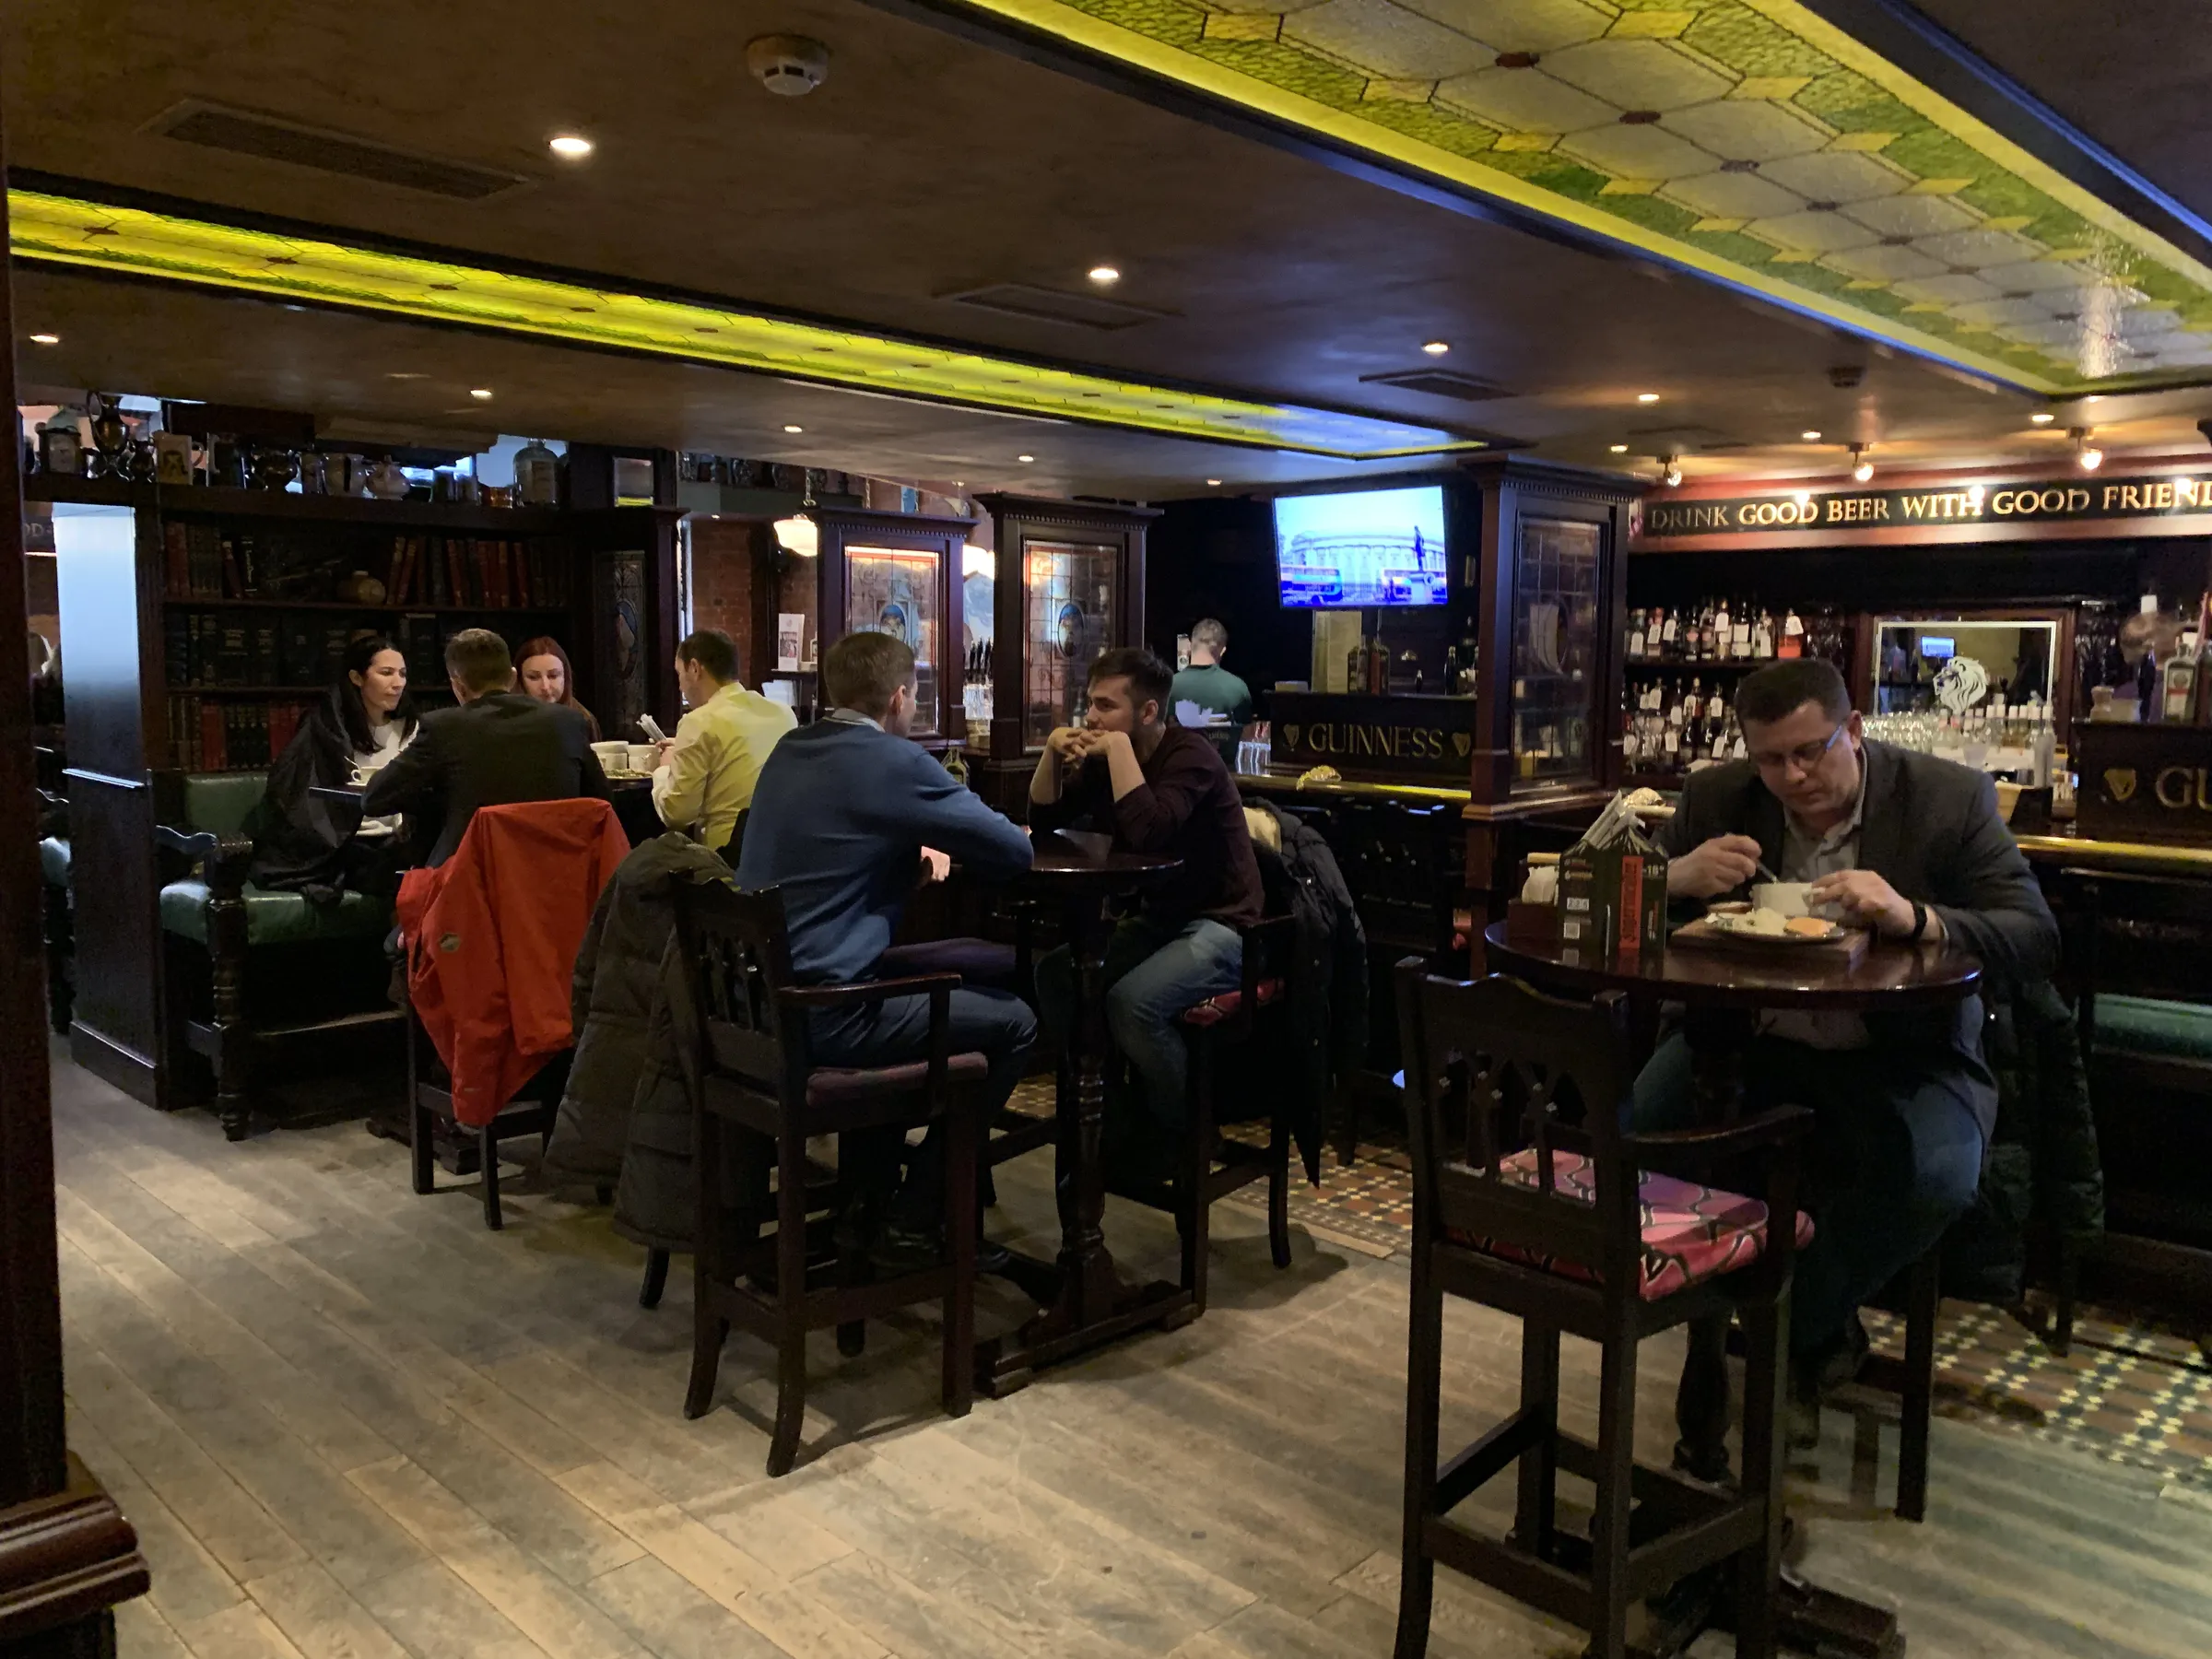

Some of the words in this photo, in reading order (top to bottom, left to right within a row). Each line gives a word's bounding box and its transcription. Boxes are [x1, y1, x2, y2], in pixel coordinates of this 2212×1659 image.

[1651, 505, 1730, 530] DRINK
[1738, 500, 1819, 525] GOOD
[1827, 498, 1890, 523] BEER
[1901, 490, 1983, 519] WITH
[1992, 487, 2091, 515] GOOD
[1308, 723, 1445, 759] GUINNESS
